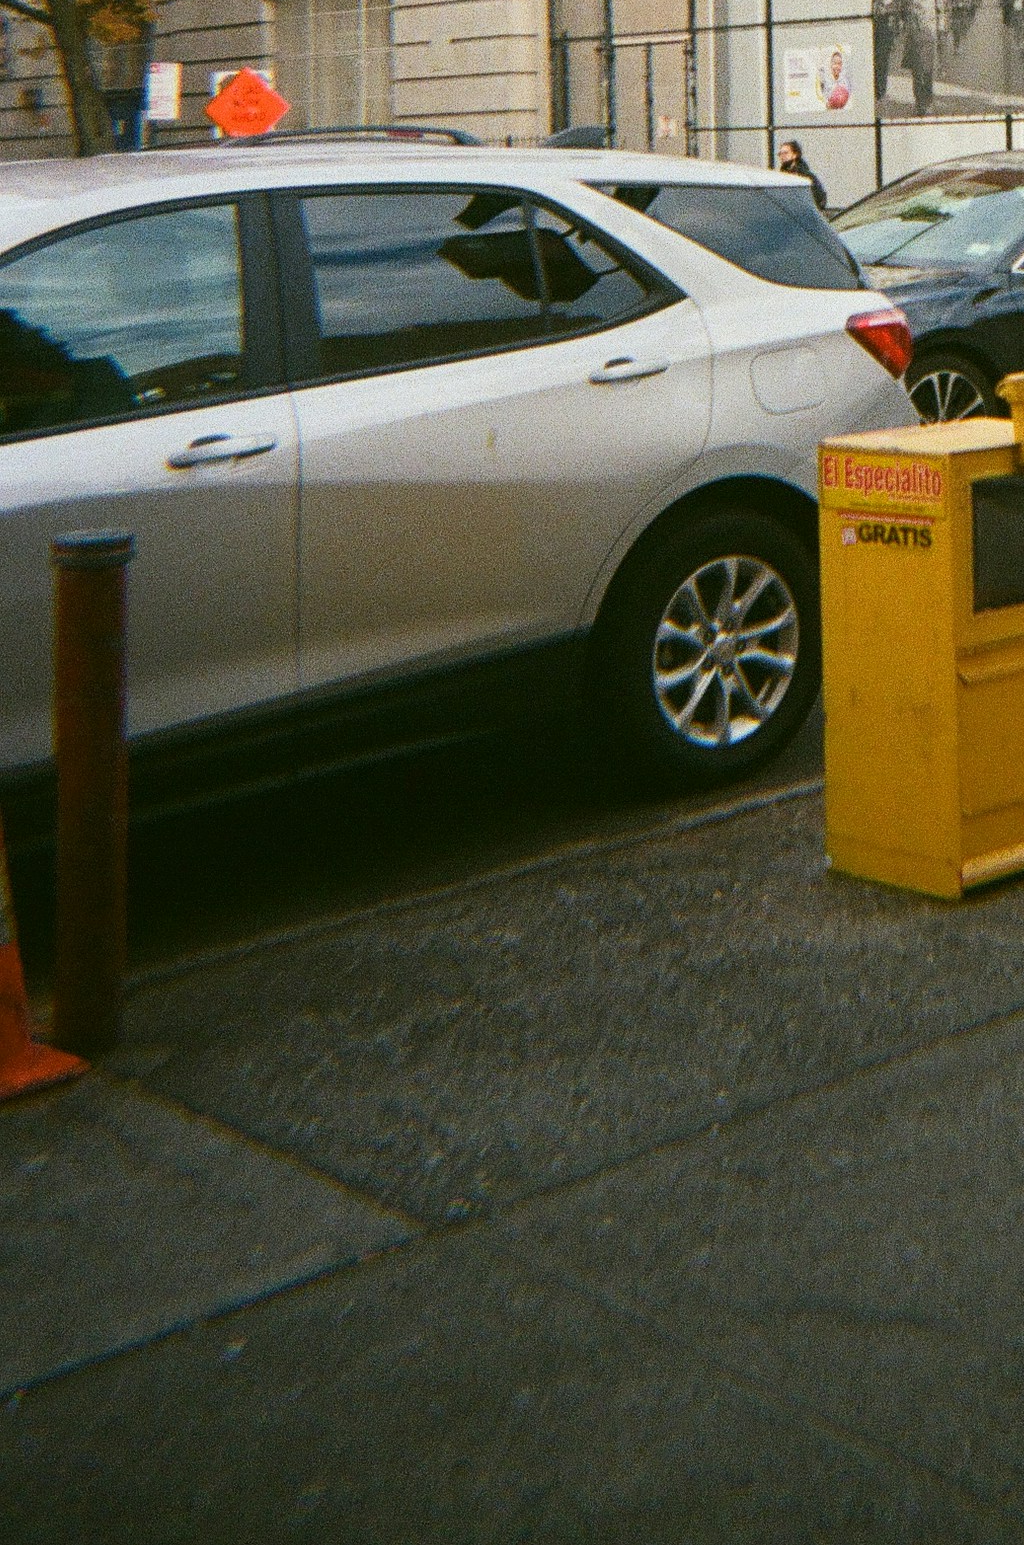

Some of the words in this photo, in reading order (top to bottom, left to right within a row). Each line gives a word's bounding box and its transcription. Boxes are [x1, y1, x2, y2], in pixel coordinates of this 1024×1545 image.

[822, 455, 839, 488] El
[844, 456, 942, 498] Especialito
[858, 520, 932, 547] GRATIS
